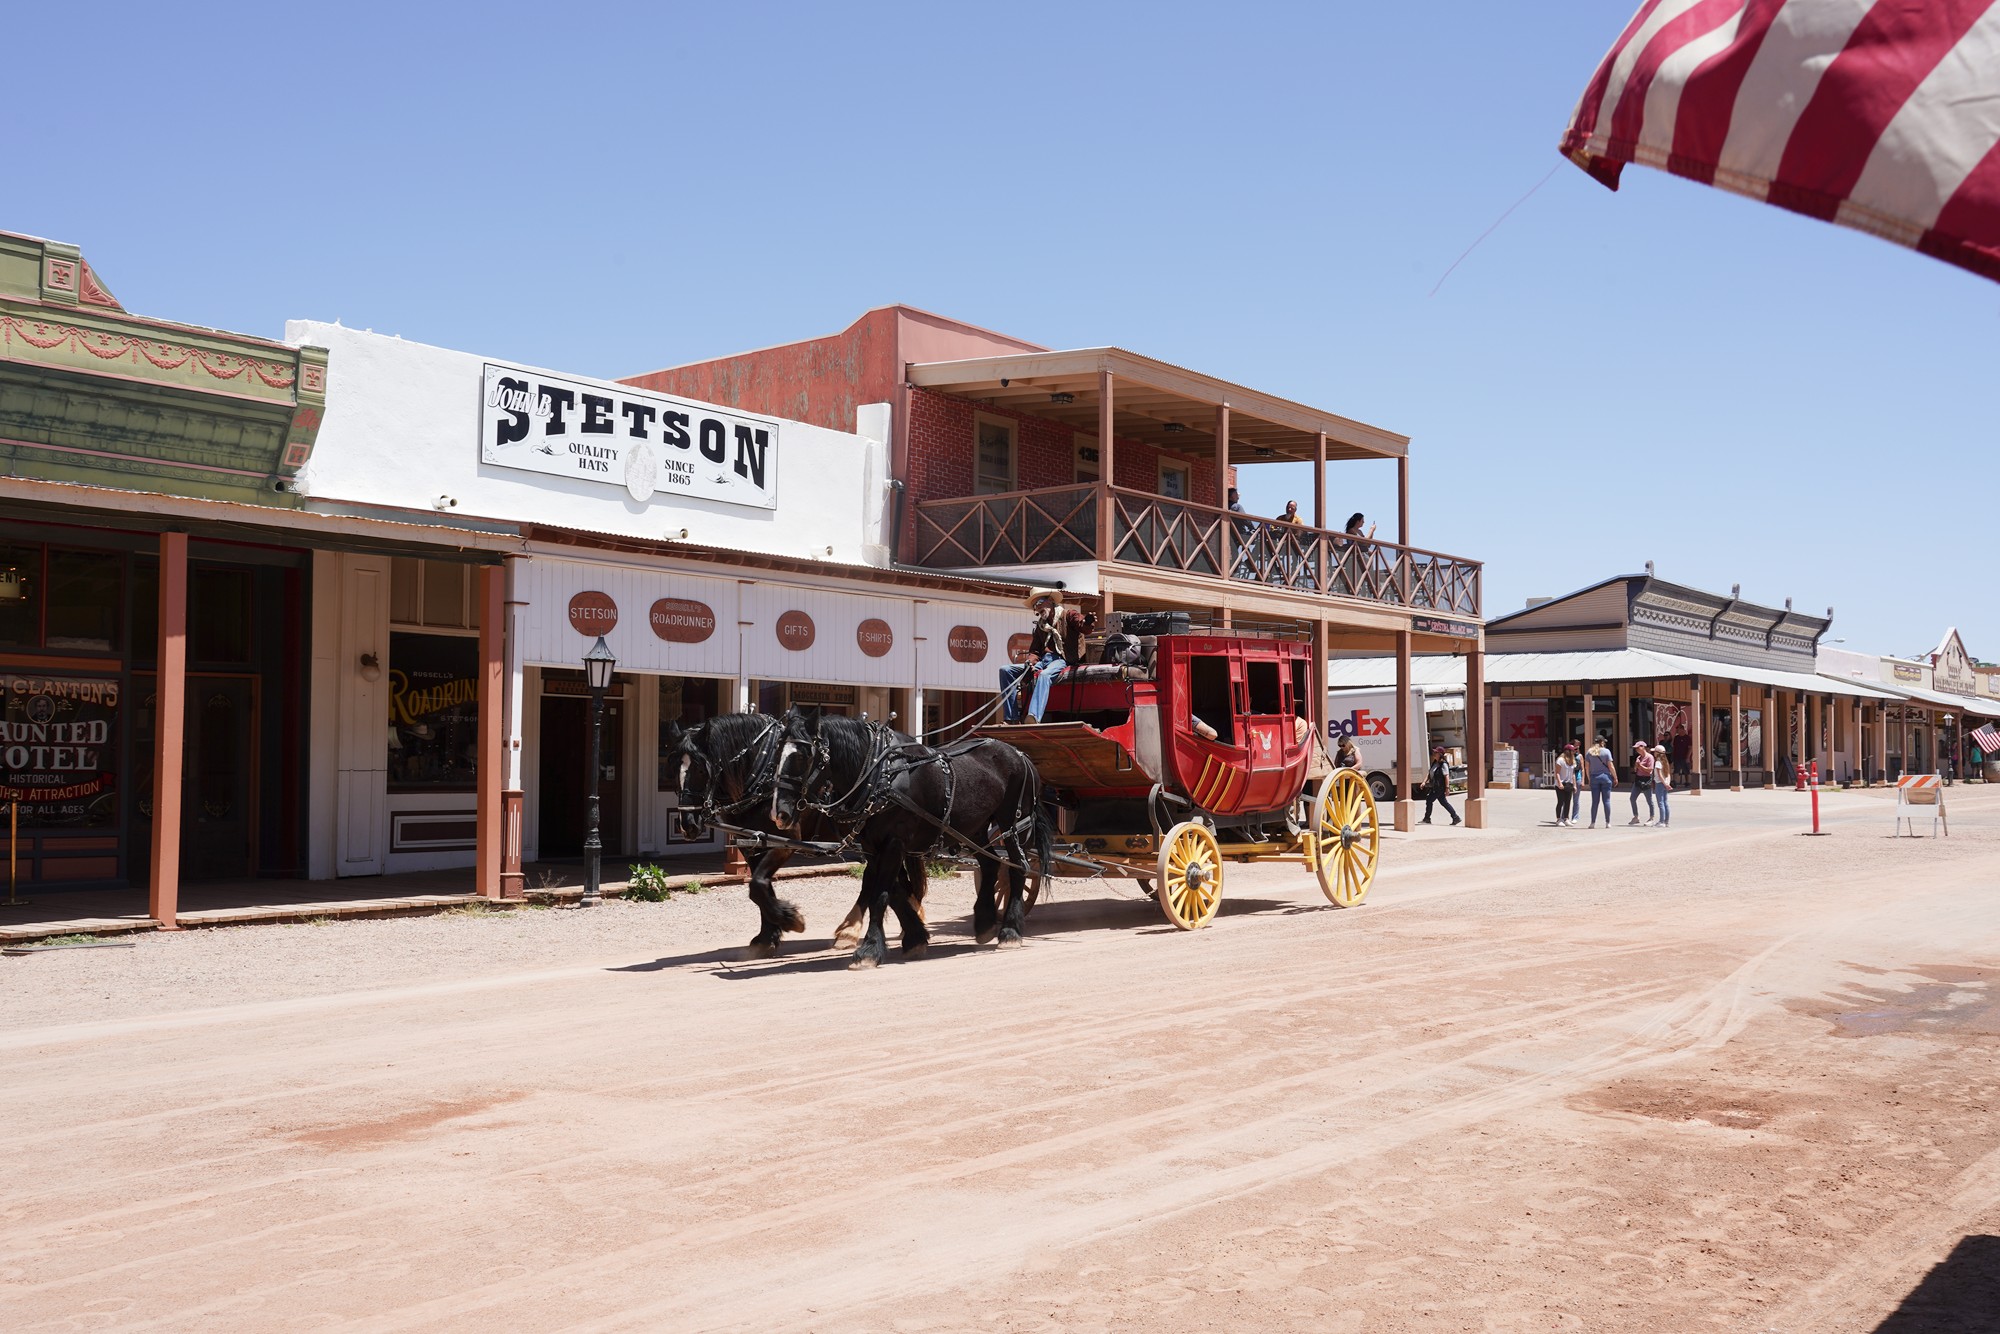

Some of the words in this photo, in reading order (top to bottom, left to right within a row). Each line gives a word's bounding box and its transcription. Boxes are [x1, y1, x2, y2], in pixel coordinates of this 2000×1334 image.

[487, 384, 536, 414] JOHN
[536, 393, 554, 419] B.
[496, 376, 769, 490] STETSON
[568, 442, 619, 461] QUALITY
[578, 457, 609, 473] HATS
[664, 459, 695, 474] SINCE
[668, 472, 691, 486] 1865
[570, 607, 617, 621] STETSON
[652, 612, 713, 629] ROADRUNNER
[784, 624, 809, 637] GIFTS
[949, 638, 987, 650] MOCCASINS
[413, 671, 454, 679] RUSSELL'S
[13, 680, 119, 707] CLANTON'S
[389, 668, 479, 725] ROADRUN
[1358, 738, 1382, 746] Ground
[0, 745, 98, 770] OTEL
[9, 774, 67, 784] HISTORICAL
[29, 780, 100, 801] ATTRACTION
[38, 805, 55, 815] ALL
[61, 805, 84, 814] AGES
